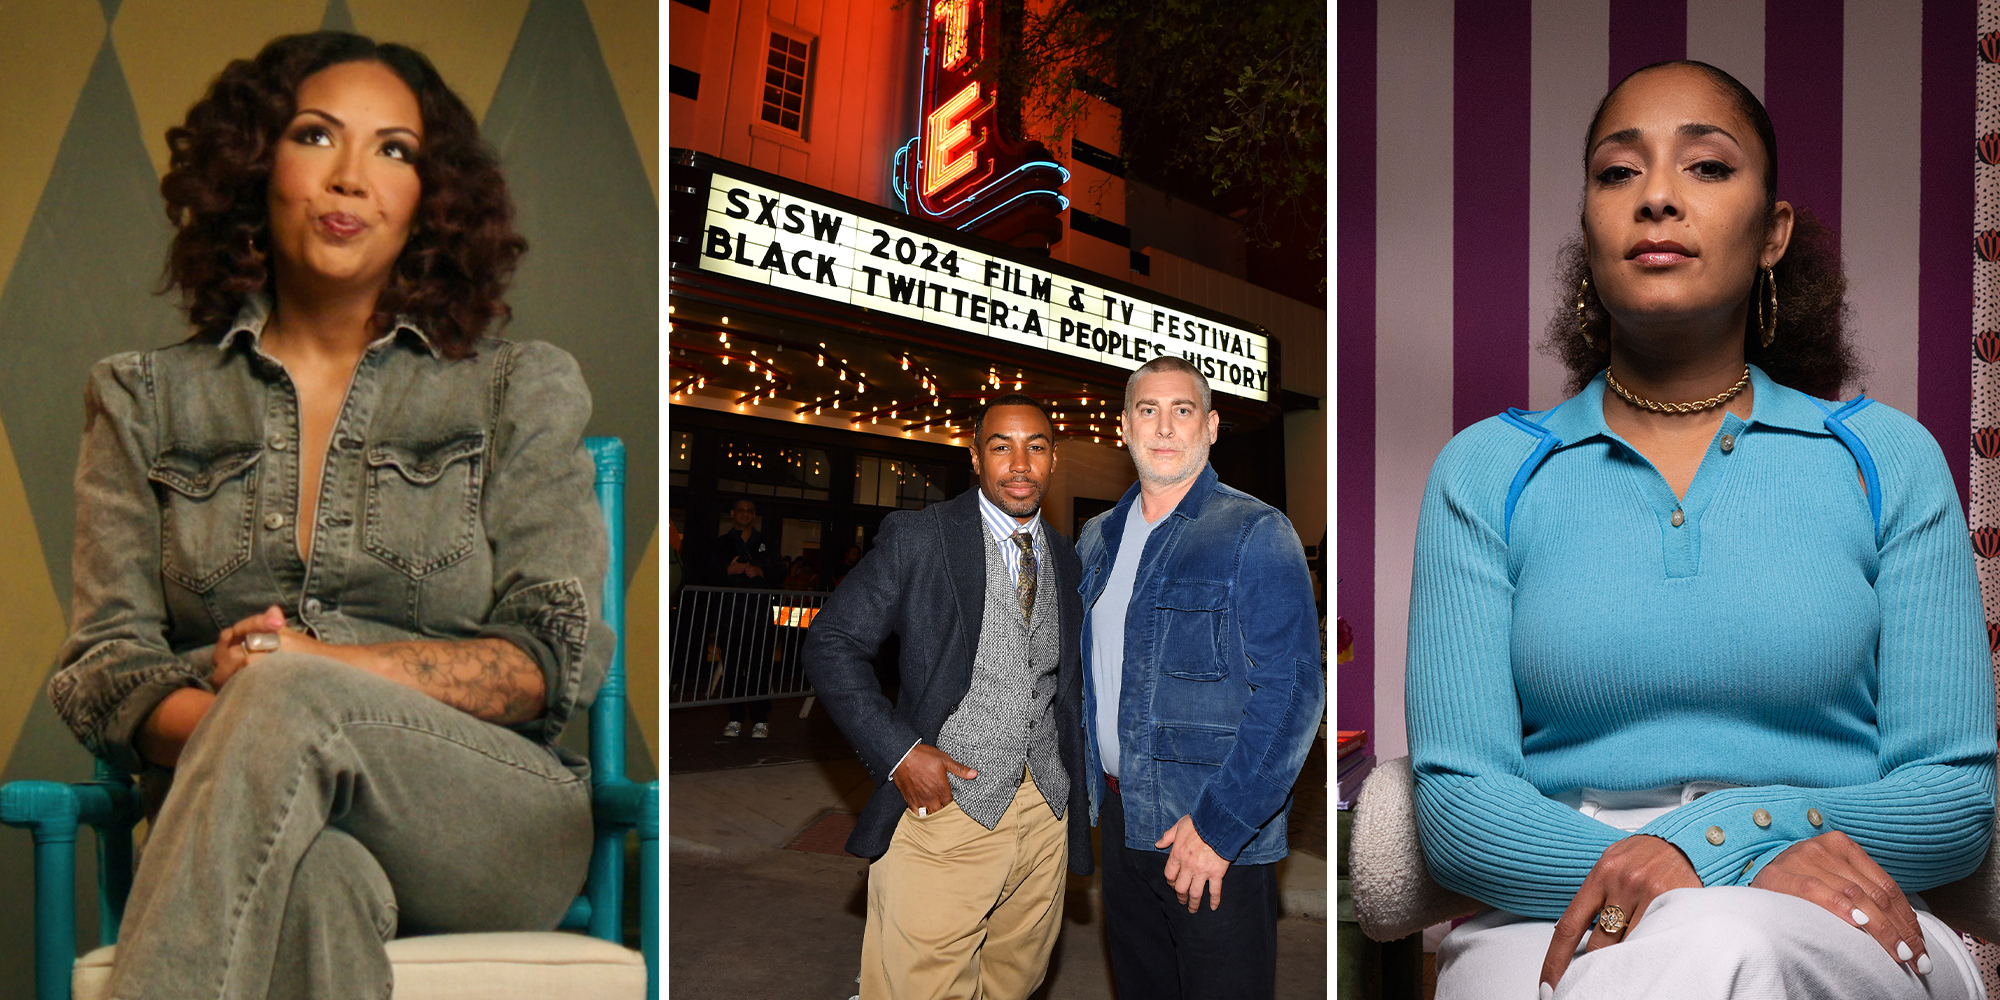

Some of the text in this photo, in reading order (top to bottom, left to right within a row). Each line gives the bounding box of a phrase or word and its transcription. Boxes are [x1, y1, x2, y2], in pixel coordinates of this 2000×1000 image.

[706, 225, 837, 287] BLACK
[726, 188, 1255, 359] SXSW 2024 FILM & TV FESTIVAL
